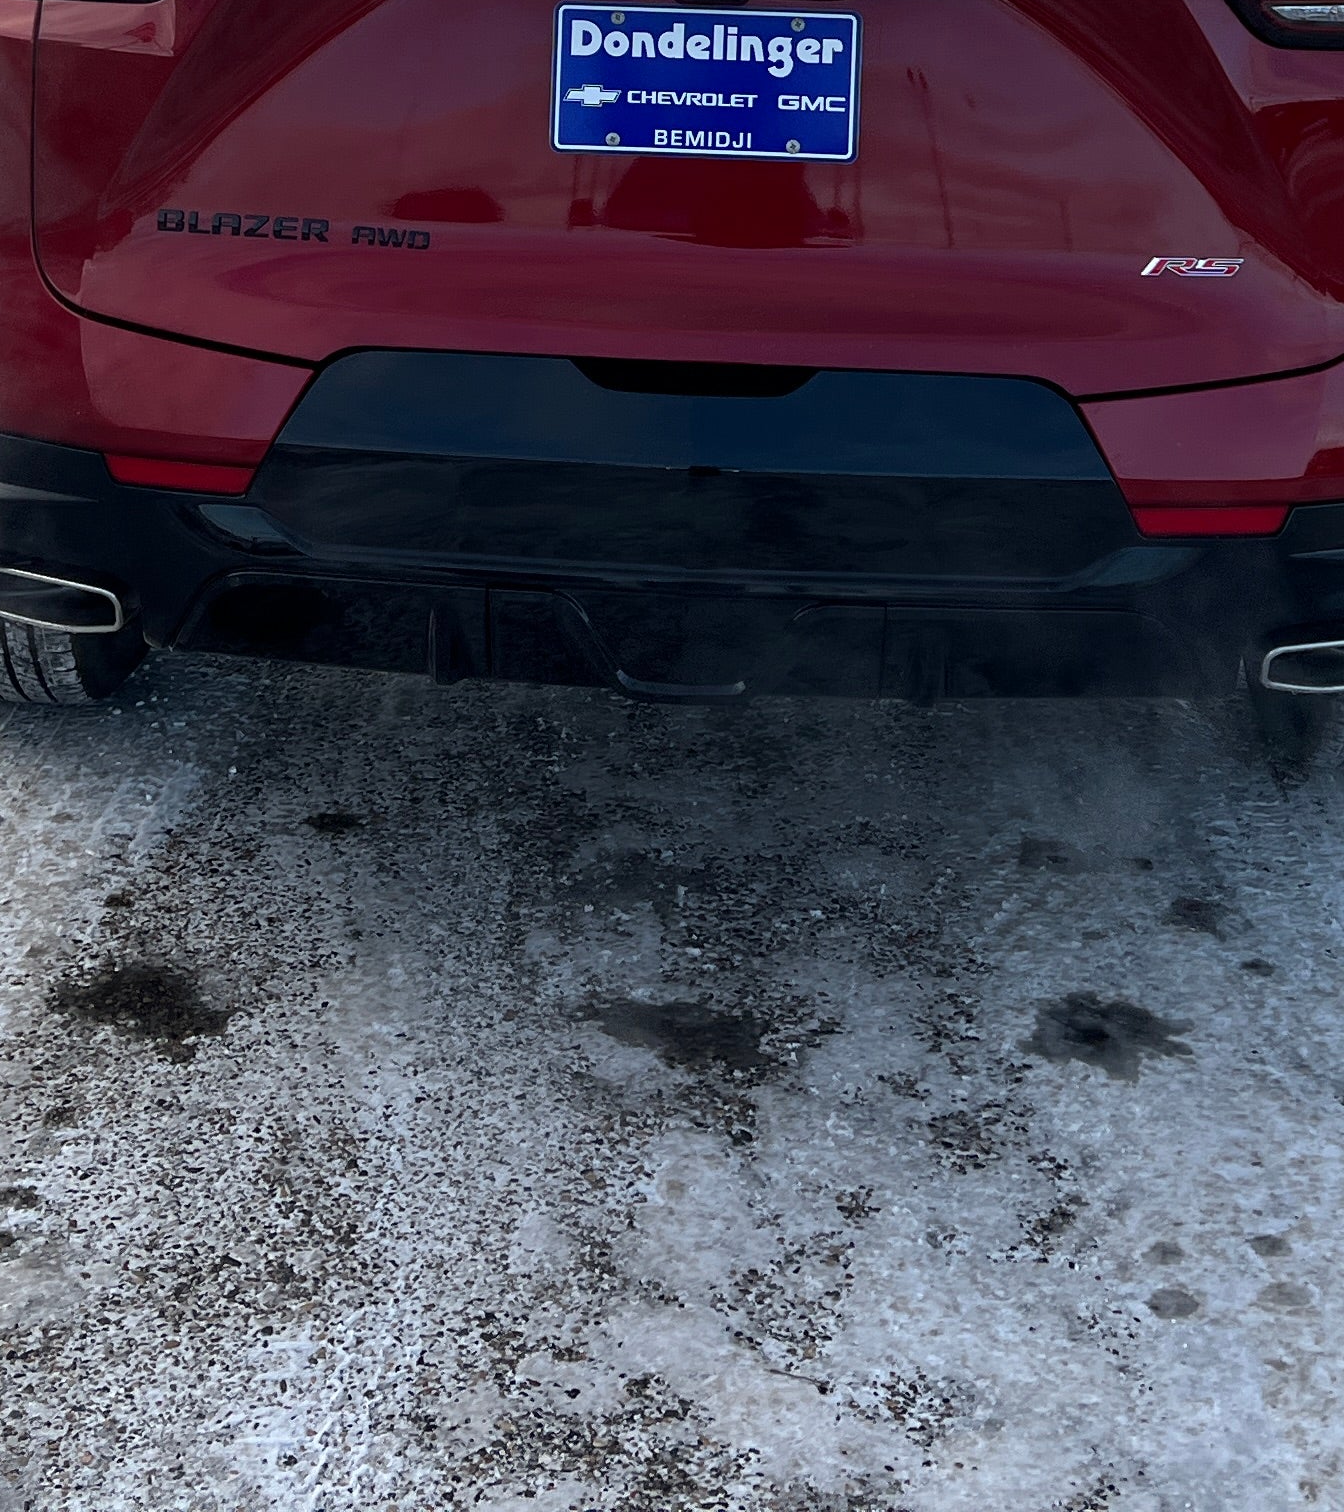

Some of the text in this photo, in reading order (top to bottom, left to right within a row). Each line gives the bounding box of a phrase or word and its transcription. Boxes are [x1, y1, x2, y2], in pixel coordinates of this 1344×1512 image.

[570, 19, 844, 78] Dondelinger
[627, 90, 846, 112] CHEVROLET GMC
[654, 129, 752, 149] BEMIDJI
[156, 208, 431, 250] BLAZER AWD
[1140, 256, 1245, 277] RS
